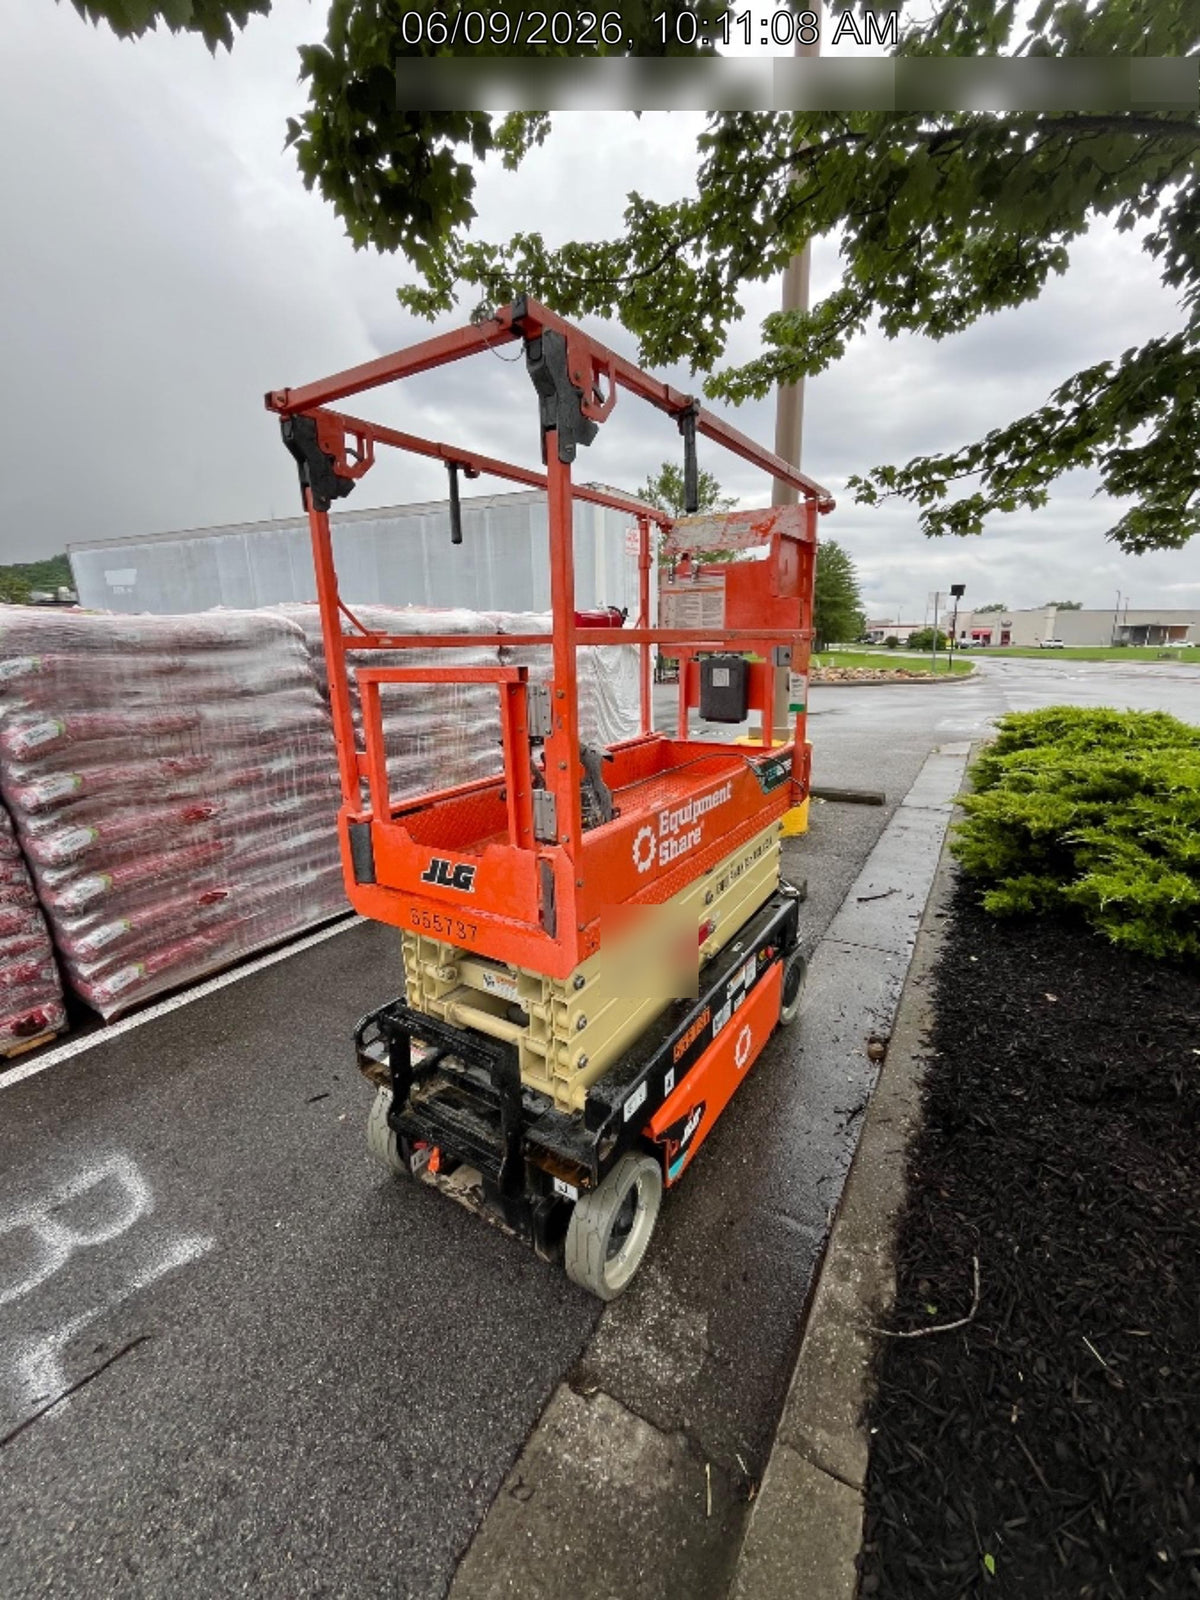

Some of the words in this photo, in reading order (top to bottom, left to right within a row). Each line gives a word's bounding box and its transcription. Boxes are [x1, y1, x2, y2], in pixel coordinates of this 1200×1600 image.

[658, 780, 733, 837] Equipment
[658, 826, 703, 867] Share
[421, 857, 475, 893] JLG
